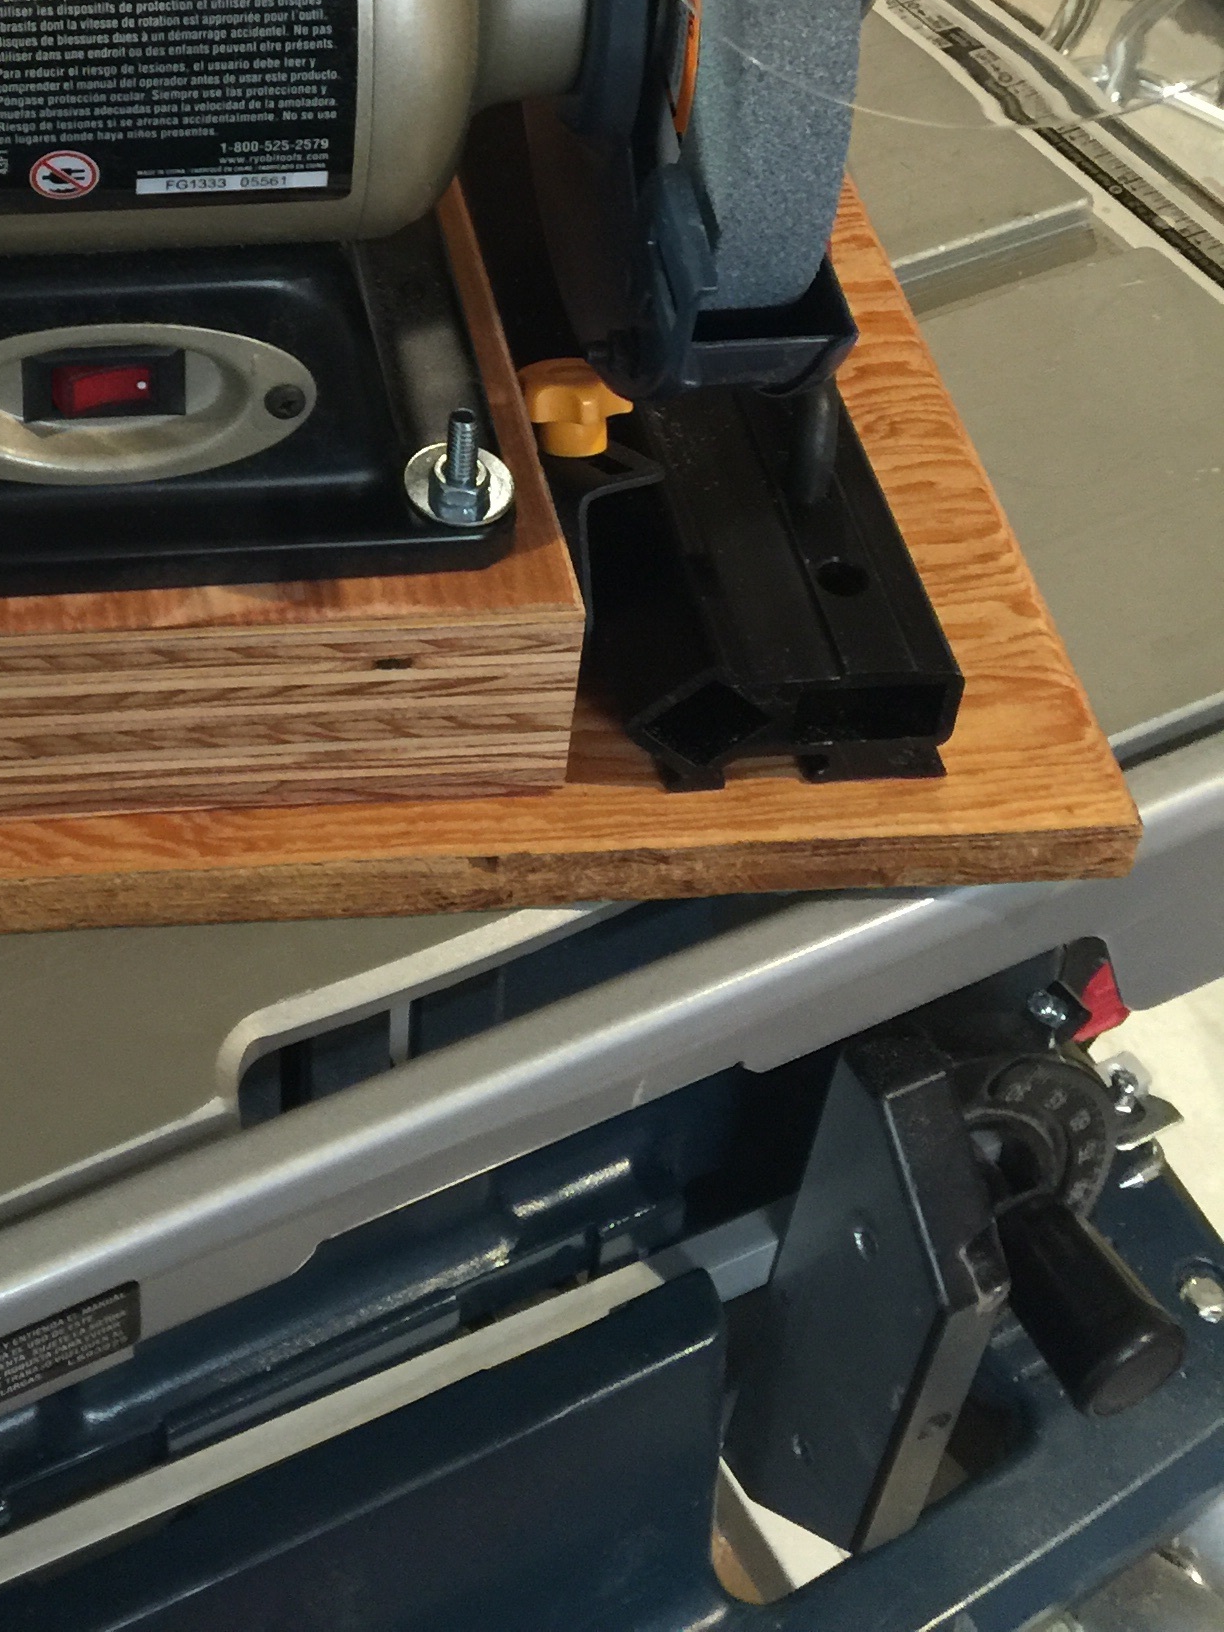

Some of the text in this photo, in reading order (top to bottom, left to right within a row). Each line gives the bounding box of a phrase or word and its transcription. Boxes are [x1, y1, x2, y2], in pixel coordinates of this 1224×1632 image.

[220, 138, 328, 153] 1-800-525-2579
[166, 176, 287, 190] FG1333 05561
